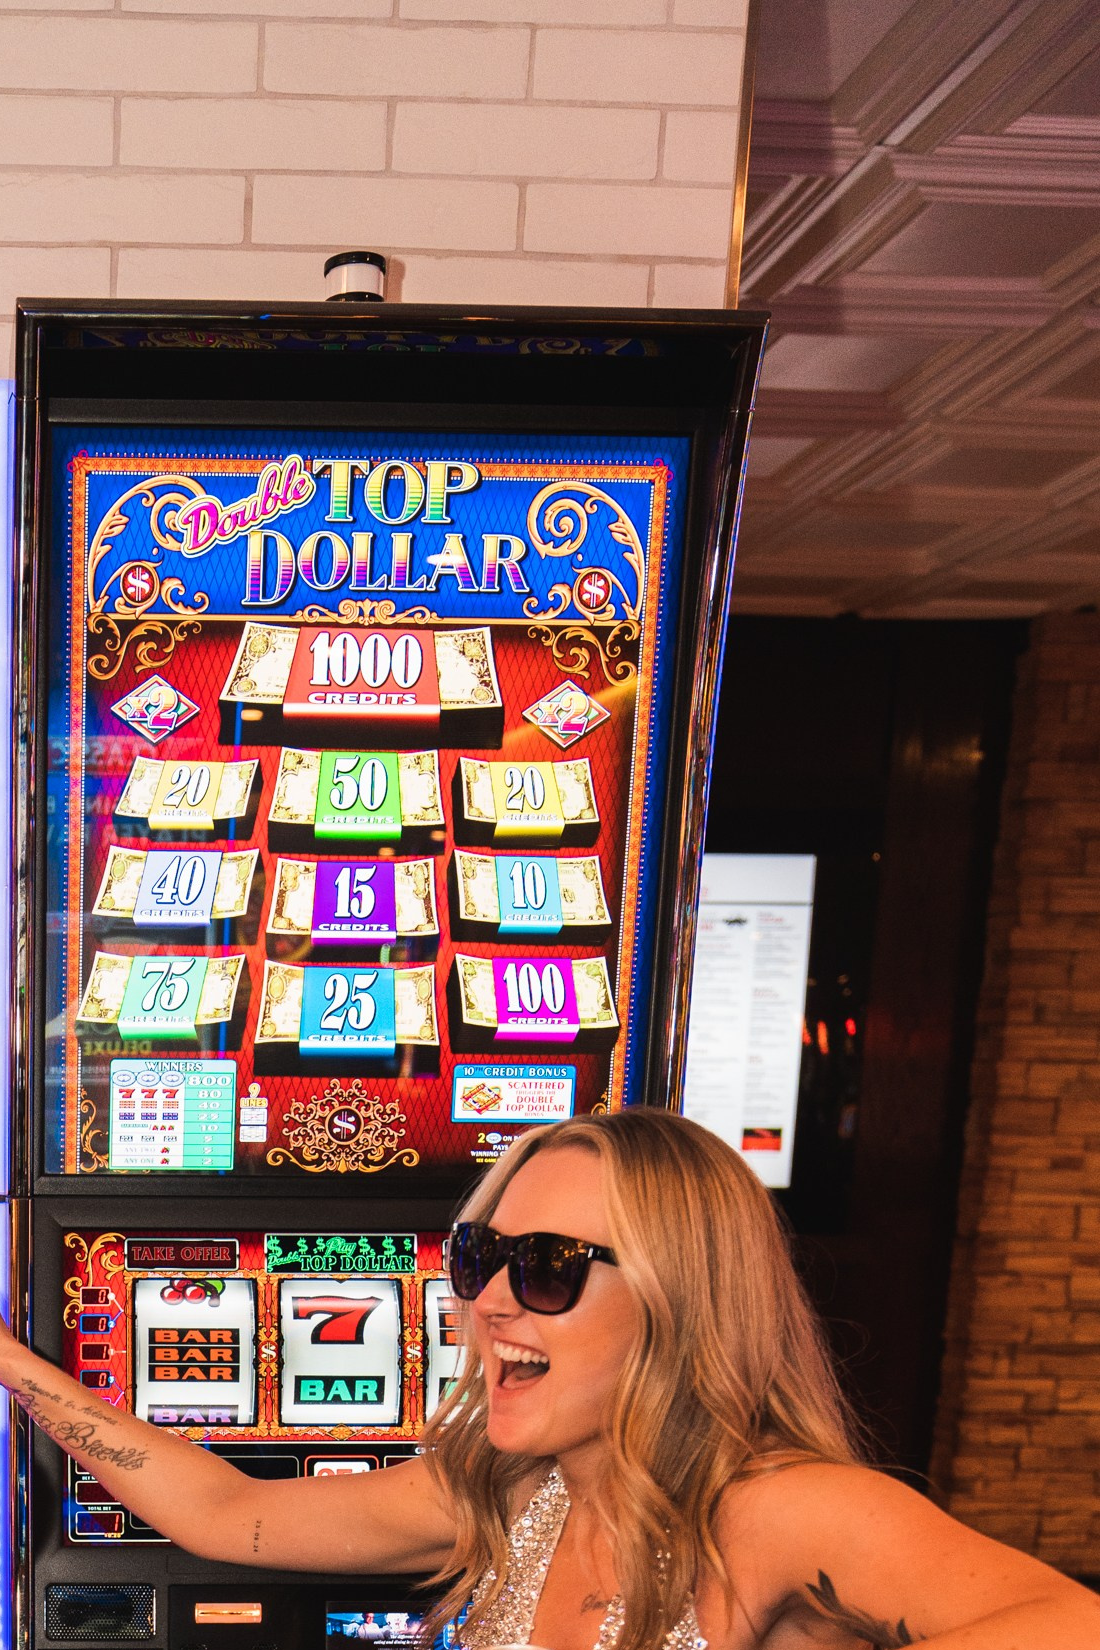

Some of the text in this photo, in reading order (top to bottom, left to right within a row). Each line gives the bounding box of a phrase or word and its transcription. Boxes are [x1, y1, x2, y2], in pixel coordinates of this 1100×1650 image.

[312, 460, 478, 524] TOP
[181, 458, 314, 556] Double
[242, 531, 529, 606] DOLLAR
[309, 632, 423, 688] 1000
[307, 692, 418, 706] CREDITS
[161, 764, 212, 808] 20
[330, 755, 389, 812] 50
[504, 765, 546, 812] 20
[321, 815, 395, 825] CREDITS
[502, 813, 562, 823] CREDITS
[151, 855, 207, 907] 40
[508, 861, 548, 910] 10
[334, 864, 378, 919] 15
[140, 909, 205, 919] CREDITS
[504, 913, 559, 922] CREDITS
[318, 922, 391, 932] CREDITS
[140, 958, 194, 1012] 75
[502, 959, 566, 1014] 100
[323, 970, 379, 1032] 25
[122, 1014, 196, 1024] CREDITS
[507, 1016, 569, 1026] CREDITS
[307, 1033, 388, 1043] CREDITS
[145, 1061, 203, 1072] WINNERS
[484, 1067, 524, 1077] CREDIT
[529, 1068, 567, 1077] BONUS
[187, 1075, 232, 1087] 800
[197, 1090, 222, 1098] 80
[248, 1083, 260, 1098] 9
[198, 1101, 220, 1109] 40
[241, 1098, 267, 1107] LINES
[505, 1104, 565, 1112] TOP DOLLAR
[478, 1133, 485, 1143] 2
[132, 1246, 231, 1261] TAKE OFFER
[325, 1236, 357, 1257] Play
[268, 1251, 415, 1272] Double TOP DOLLAR
[291, 1295, 384, 1345] 7
[154, 1330, 233, 1343] BAR
[154, 1348, 233, 1361] BAR
[154, 1367, 233, 1380] BAR
[300, 1380, 379, 1401] BAR
[153, 1409, 232, 1423] BAR
